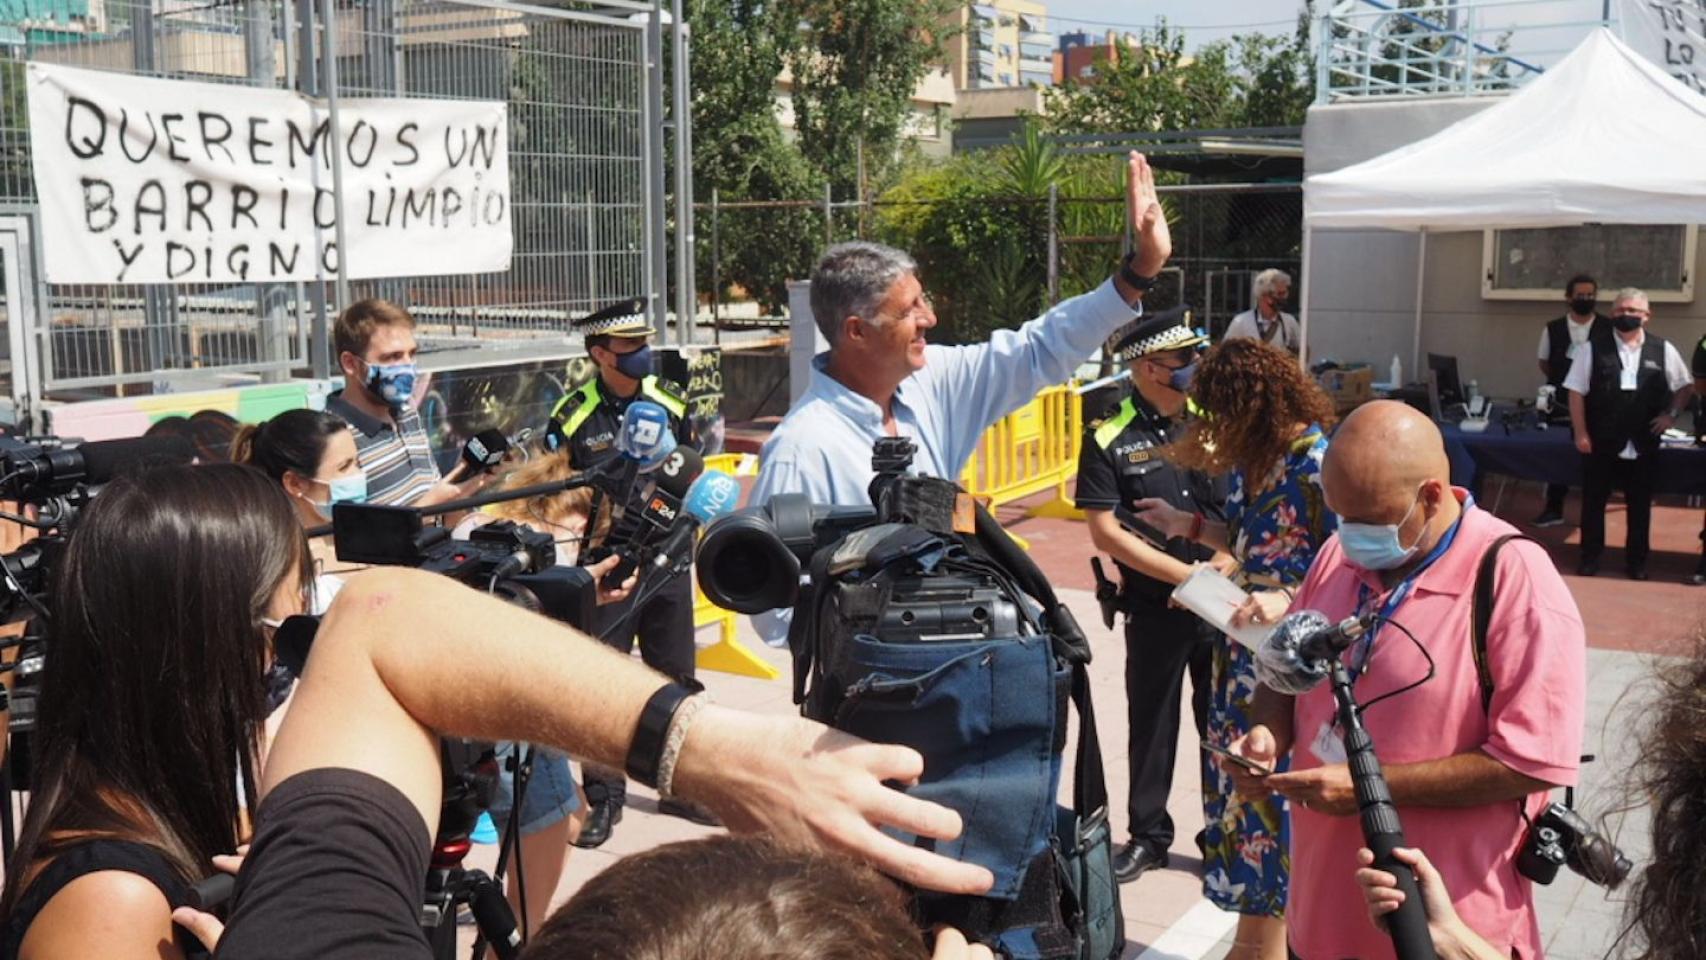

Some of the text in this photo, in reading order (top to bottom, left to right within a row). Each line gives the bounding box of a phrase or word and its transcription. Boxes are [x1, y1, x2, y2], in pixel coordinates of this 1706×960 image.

[65, 97, 499, 169] QUEREMOS UN
[112, 238, 144, 282] Y
[663, 452, 685, 477] 3
